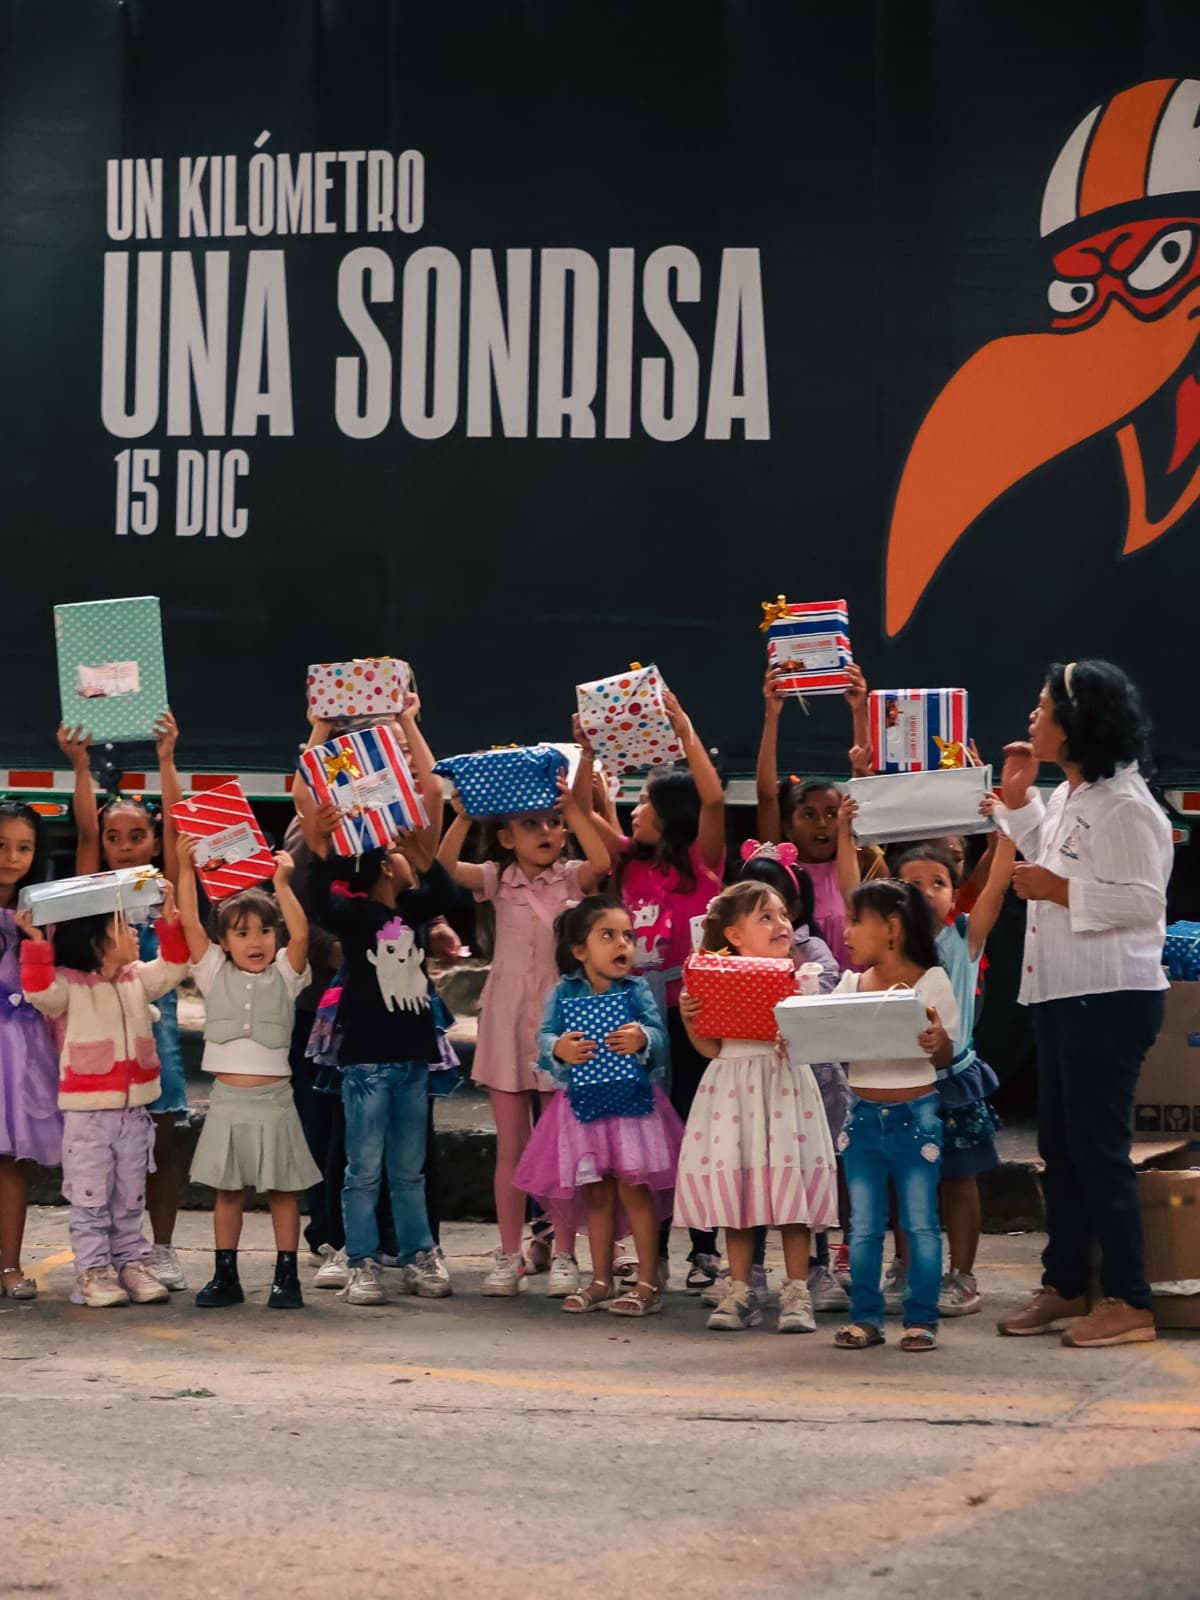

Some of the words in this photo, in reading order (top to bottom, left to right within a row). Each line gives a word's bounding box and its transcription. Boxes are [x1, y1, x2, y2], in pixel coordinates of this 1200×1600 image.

[107, 157, 163, 240] UN
[179, 130, 425, 238] KILÓMETRO
[101, 249, 295, 438] UNA
[335, 245, 771, 441] SONRISA
[114, 448, 161, 535] 15
[175, 448, 250, 538] DIC
